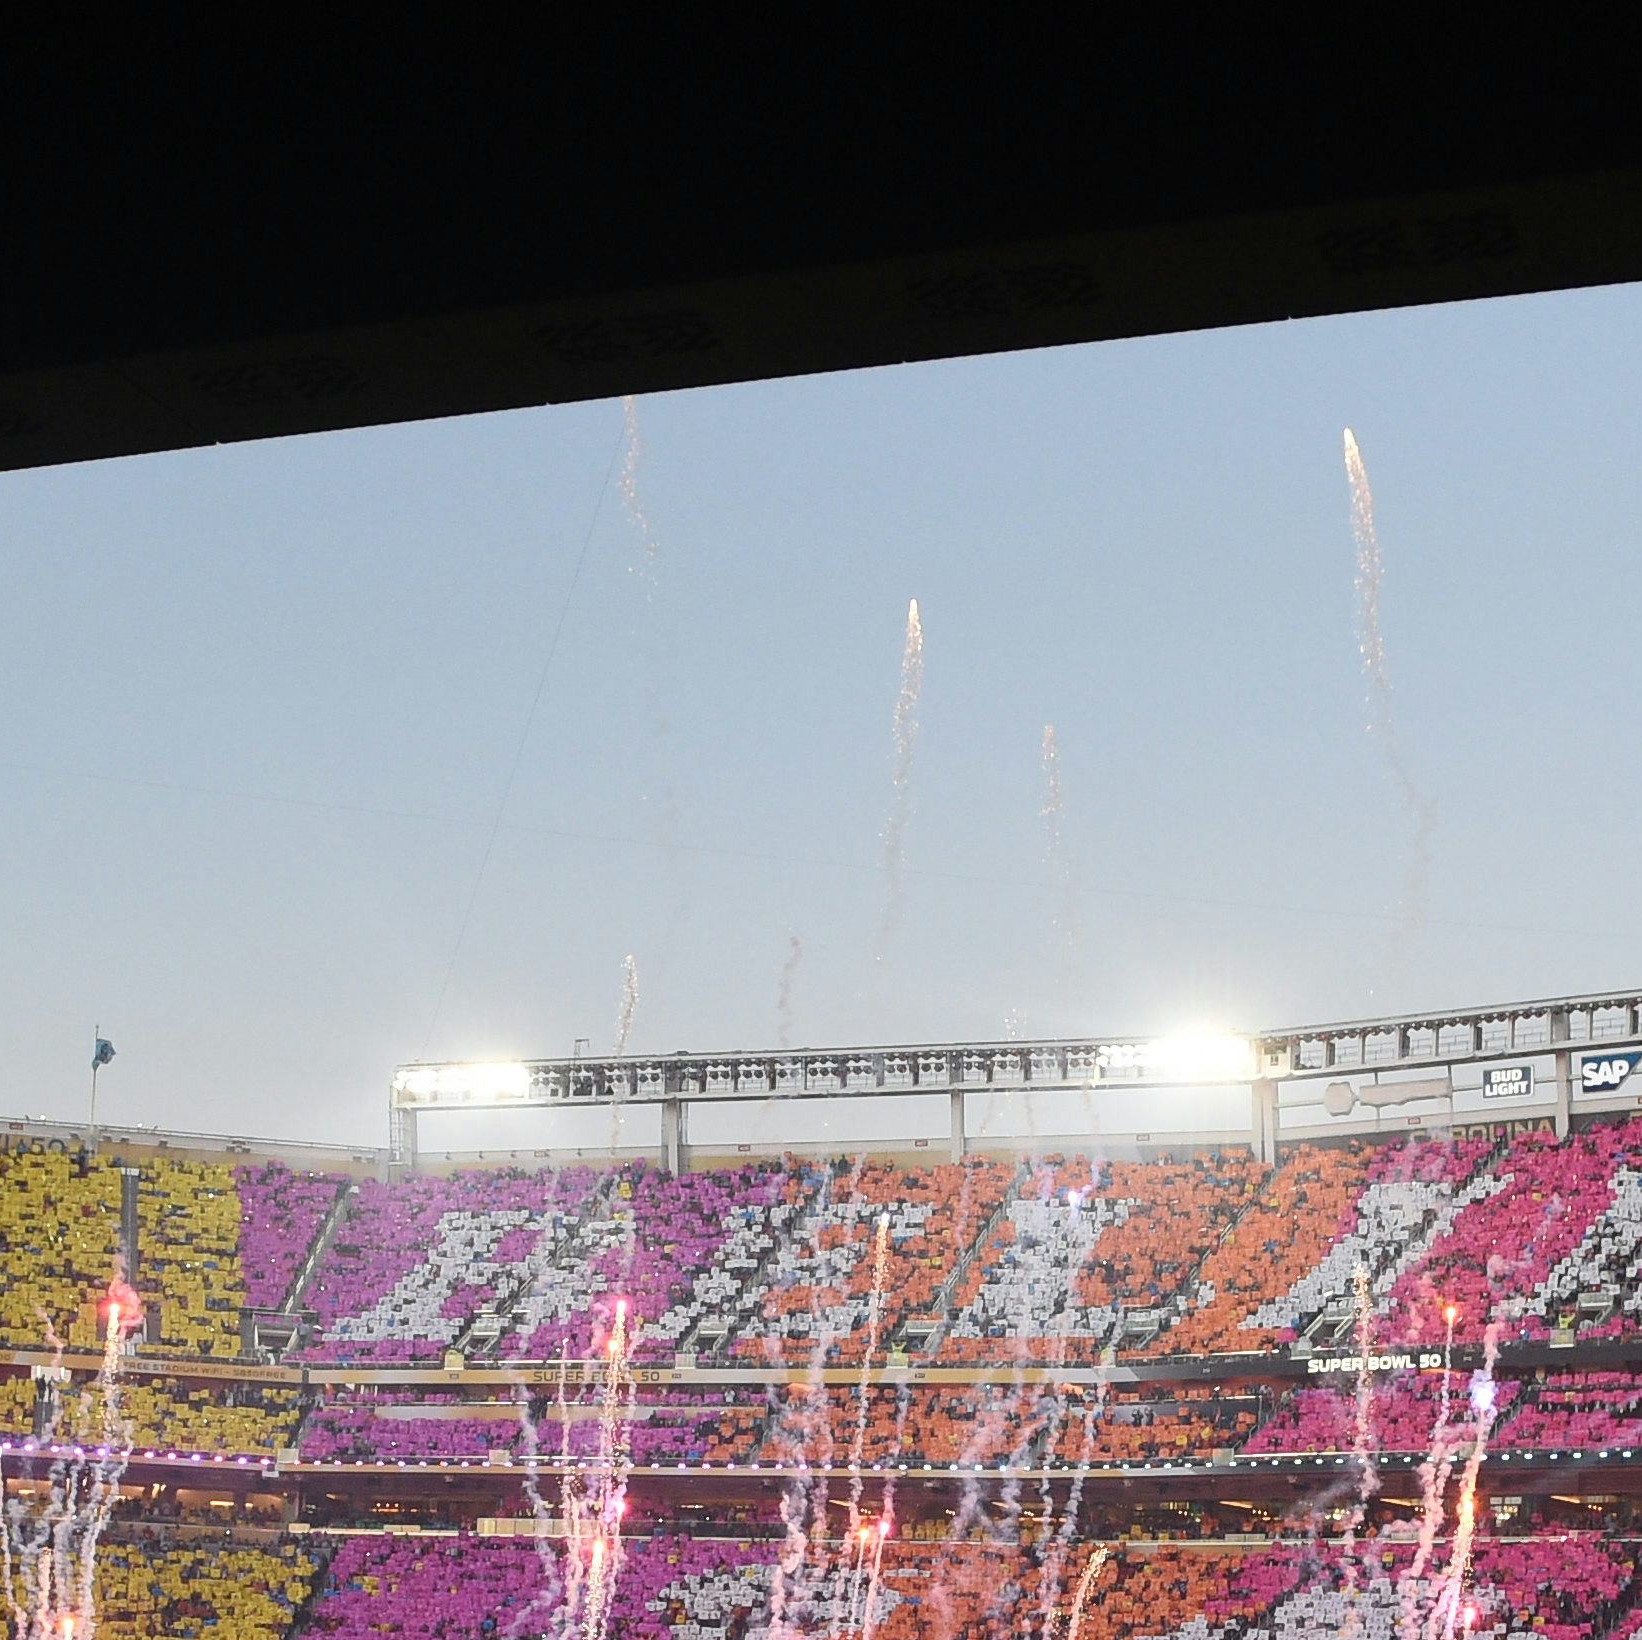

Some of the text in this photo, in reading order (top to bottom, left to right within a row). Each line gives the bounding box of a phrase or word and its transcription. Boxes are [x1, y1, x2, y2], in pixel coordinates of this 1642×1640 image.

[1490, 1070, 1523, 1084] BUD
[1582, 1059, 1631, 1087] SAP
[1485, 1081, 1529, 1097] LIGHT
[1307, 1353, 1442, 1374] SUPER BOWL 50
[641, 1372, 660, 1383] 50
